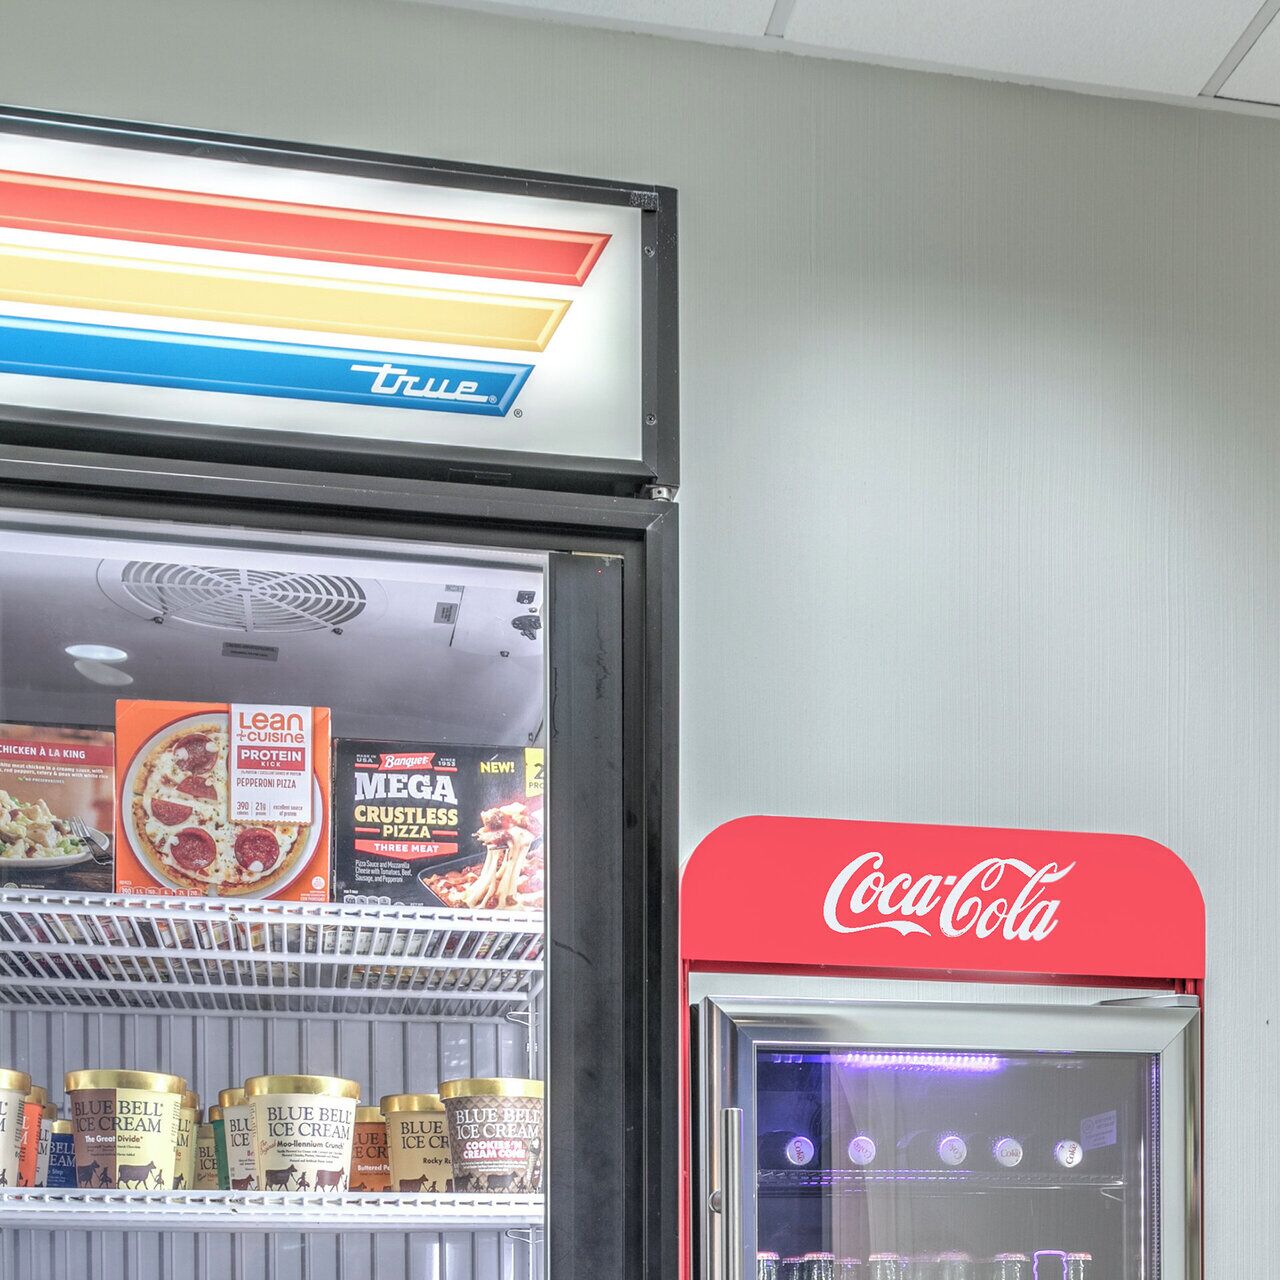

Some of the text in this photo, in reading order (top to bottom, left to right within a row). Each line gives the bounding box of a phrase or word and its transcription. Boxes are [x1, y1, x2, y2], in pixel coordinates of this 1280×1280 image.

[350, 364, 489, 403] true
[239, 711, 304, 731] Lean
[49, 748, 60, 757] LA
[63, 749, 86, 759] KING
[241, 749, 301, 762] PROTEIN
[384, 754, 430, 768] Banquet
[480, 761, 515, 774] NEW!
[237, 778, 296, 788] PEPPERONI PIZZA
[355, 771, 458, 805] MEGA
[354, 805, 458, 826] CRUSTLESS
[382, 825, 431, 838] PIZZA
[374, 843, 439, 853] THREE MEAT
[823, 852, 1077, 941] Coca-Cola
[75, 1100, 162, 1117] BLUE BELL
[267, 1106, 351, 1124] BLUE BELL
[456, 1107, 497, 1124] BLUE
[76, 1117, 94, 1132] ICE
[98, 1117, 161, 1133] CREAM
[269, 1122, 350, 1140] ICE CREAM
[400, 1120, 443, 1135] BLUE
[457, 1123, 539, 1140] ICE CREAM
[96, 1135, 115, 1143] Great
[118, 1135, 141, 1143] Divide
[231, 1133, 249, 1147] ICE
[402, 1136, 428, 1149] ICE
[423, 1157, 443, 1165] Rocky
